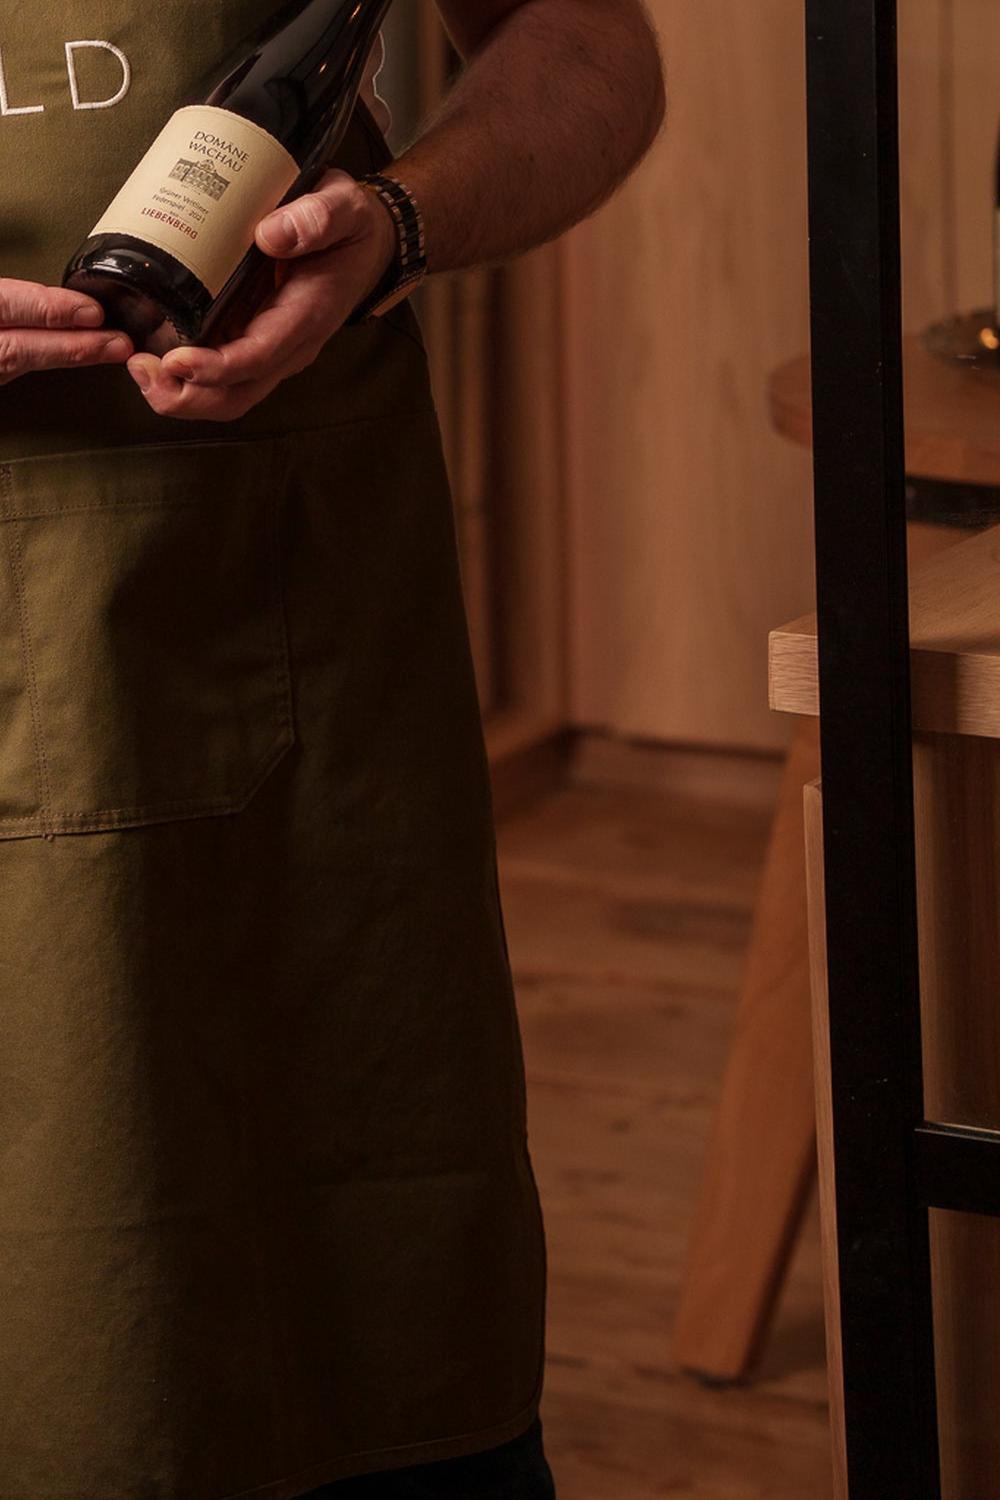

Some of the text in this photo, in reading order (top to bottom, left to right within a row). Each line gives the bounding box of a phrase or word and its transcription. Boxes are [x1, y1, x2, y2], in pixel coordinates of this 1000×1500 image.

[189, 141, 243, 172] WACHAU
[194, 131, 249, 163] DOMÄNE
[141, 207, 198, 240] LIEBENBERG
